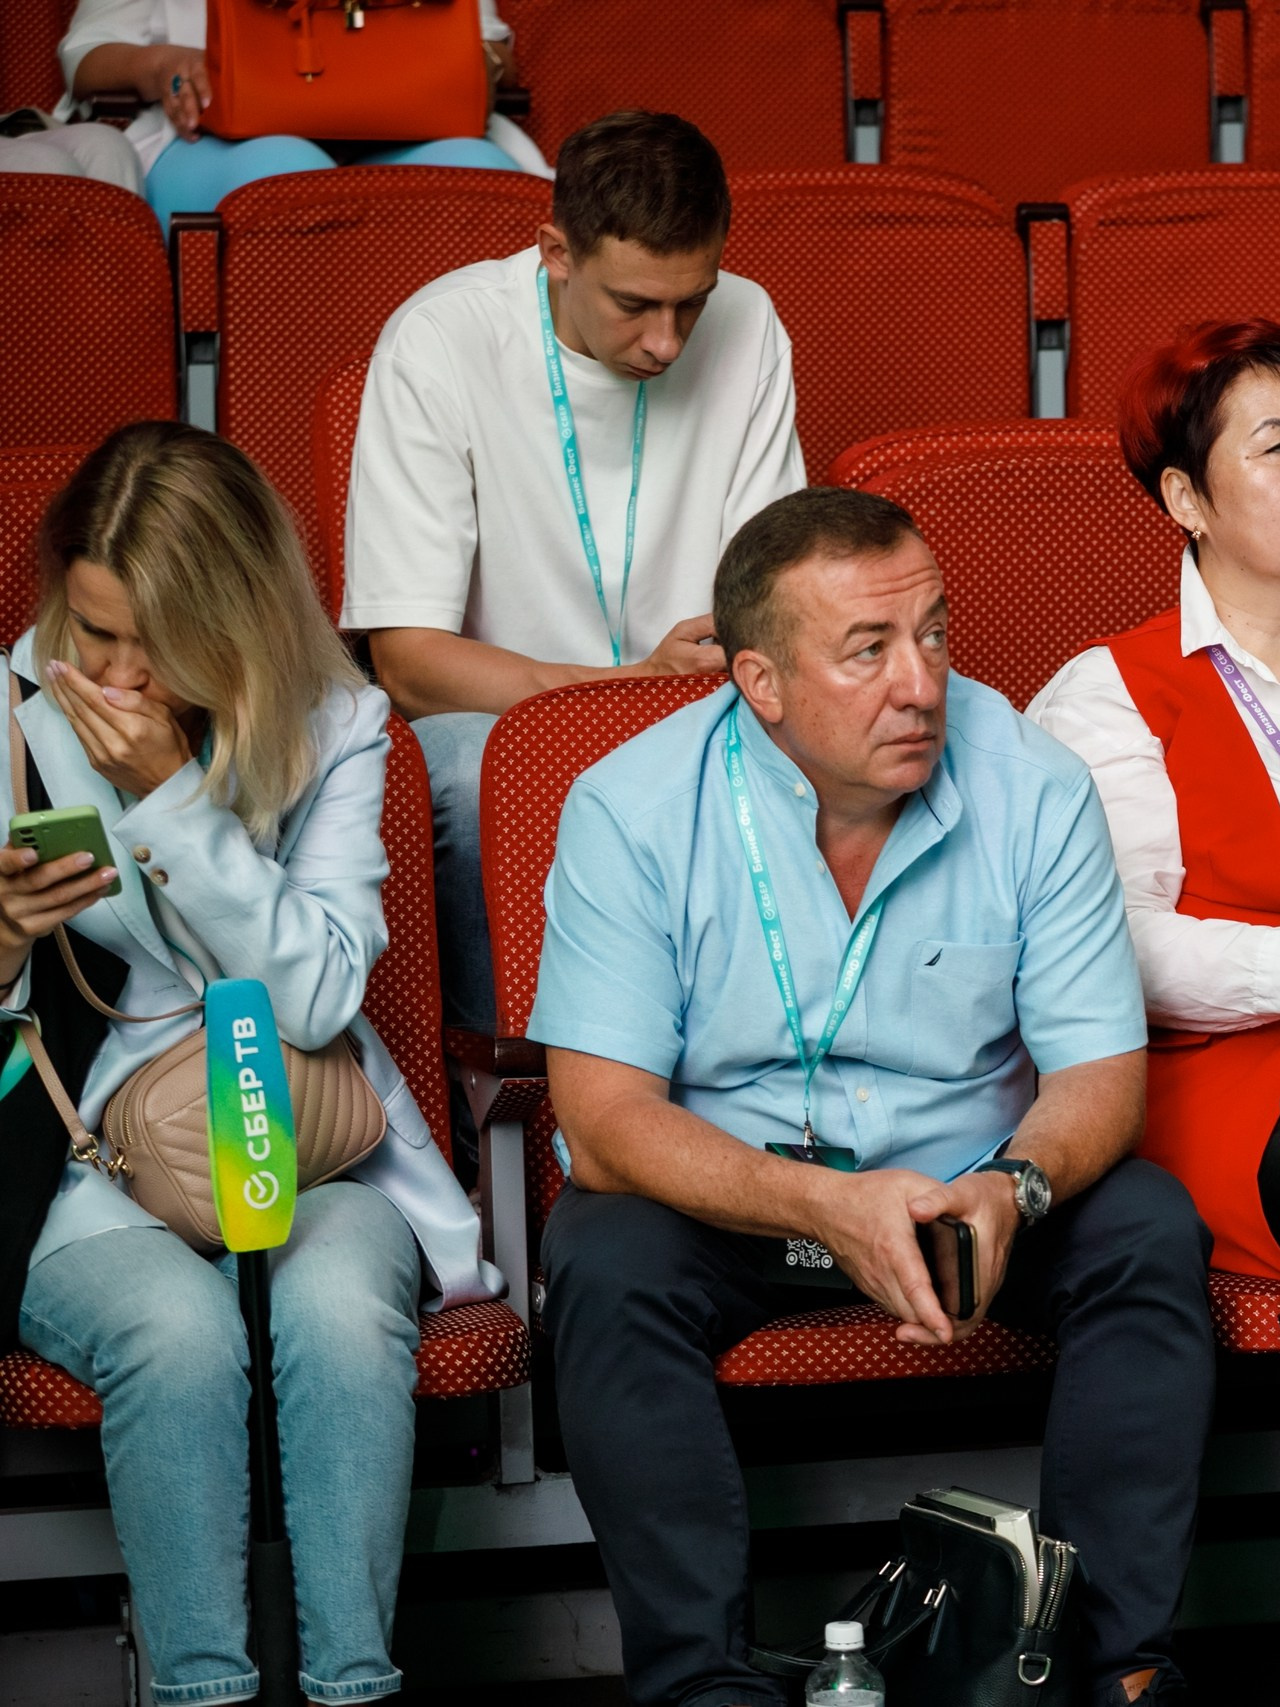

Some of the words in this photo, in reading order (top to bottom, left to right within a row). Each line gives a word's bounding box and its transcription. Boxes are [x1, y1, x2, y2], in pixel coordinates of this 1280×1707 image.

[545, 329, 555, 356] Фест
[551, 359, 563, 397] Бизнес
[558, 404, 569, 428] СБЕР
[567, 447, 577, 475] Фест
[572, 477, 585, 514] Бизнес
[1211, 647, 1227, 666] СБЕР
[1234, 679, 1253, 703] Фест
[1250, 701, 1276, 735] Бизнес
[731, 752, 740, 775] СБЕР
[738, 796, 752, 826] Фест
[746, 827, 764, 873] Бизнес
[758, 881, 771, 908] СБЕР
[769, 930, 783, 962] Фест
[853, 914, 876, 957] Бизнес
[777, 963, 794, 1008] Бизнес
[843, 959, 860, 990] Фест
[232, 1016, 259, 1063] ТВ
[826, 1013, 840, 1038] СБЕР
[238, 1067, 271, 1161] СБЕР
